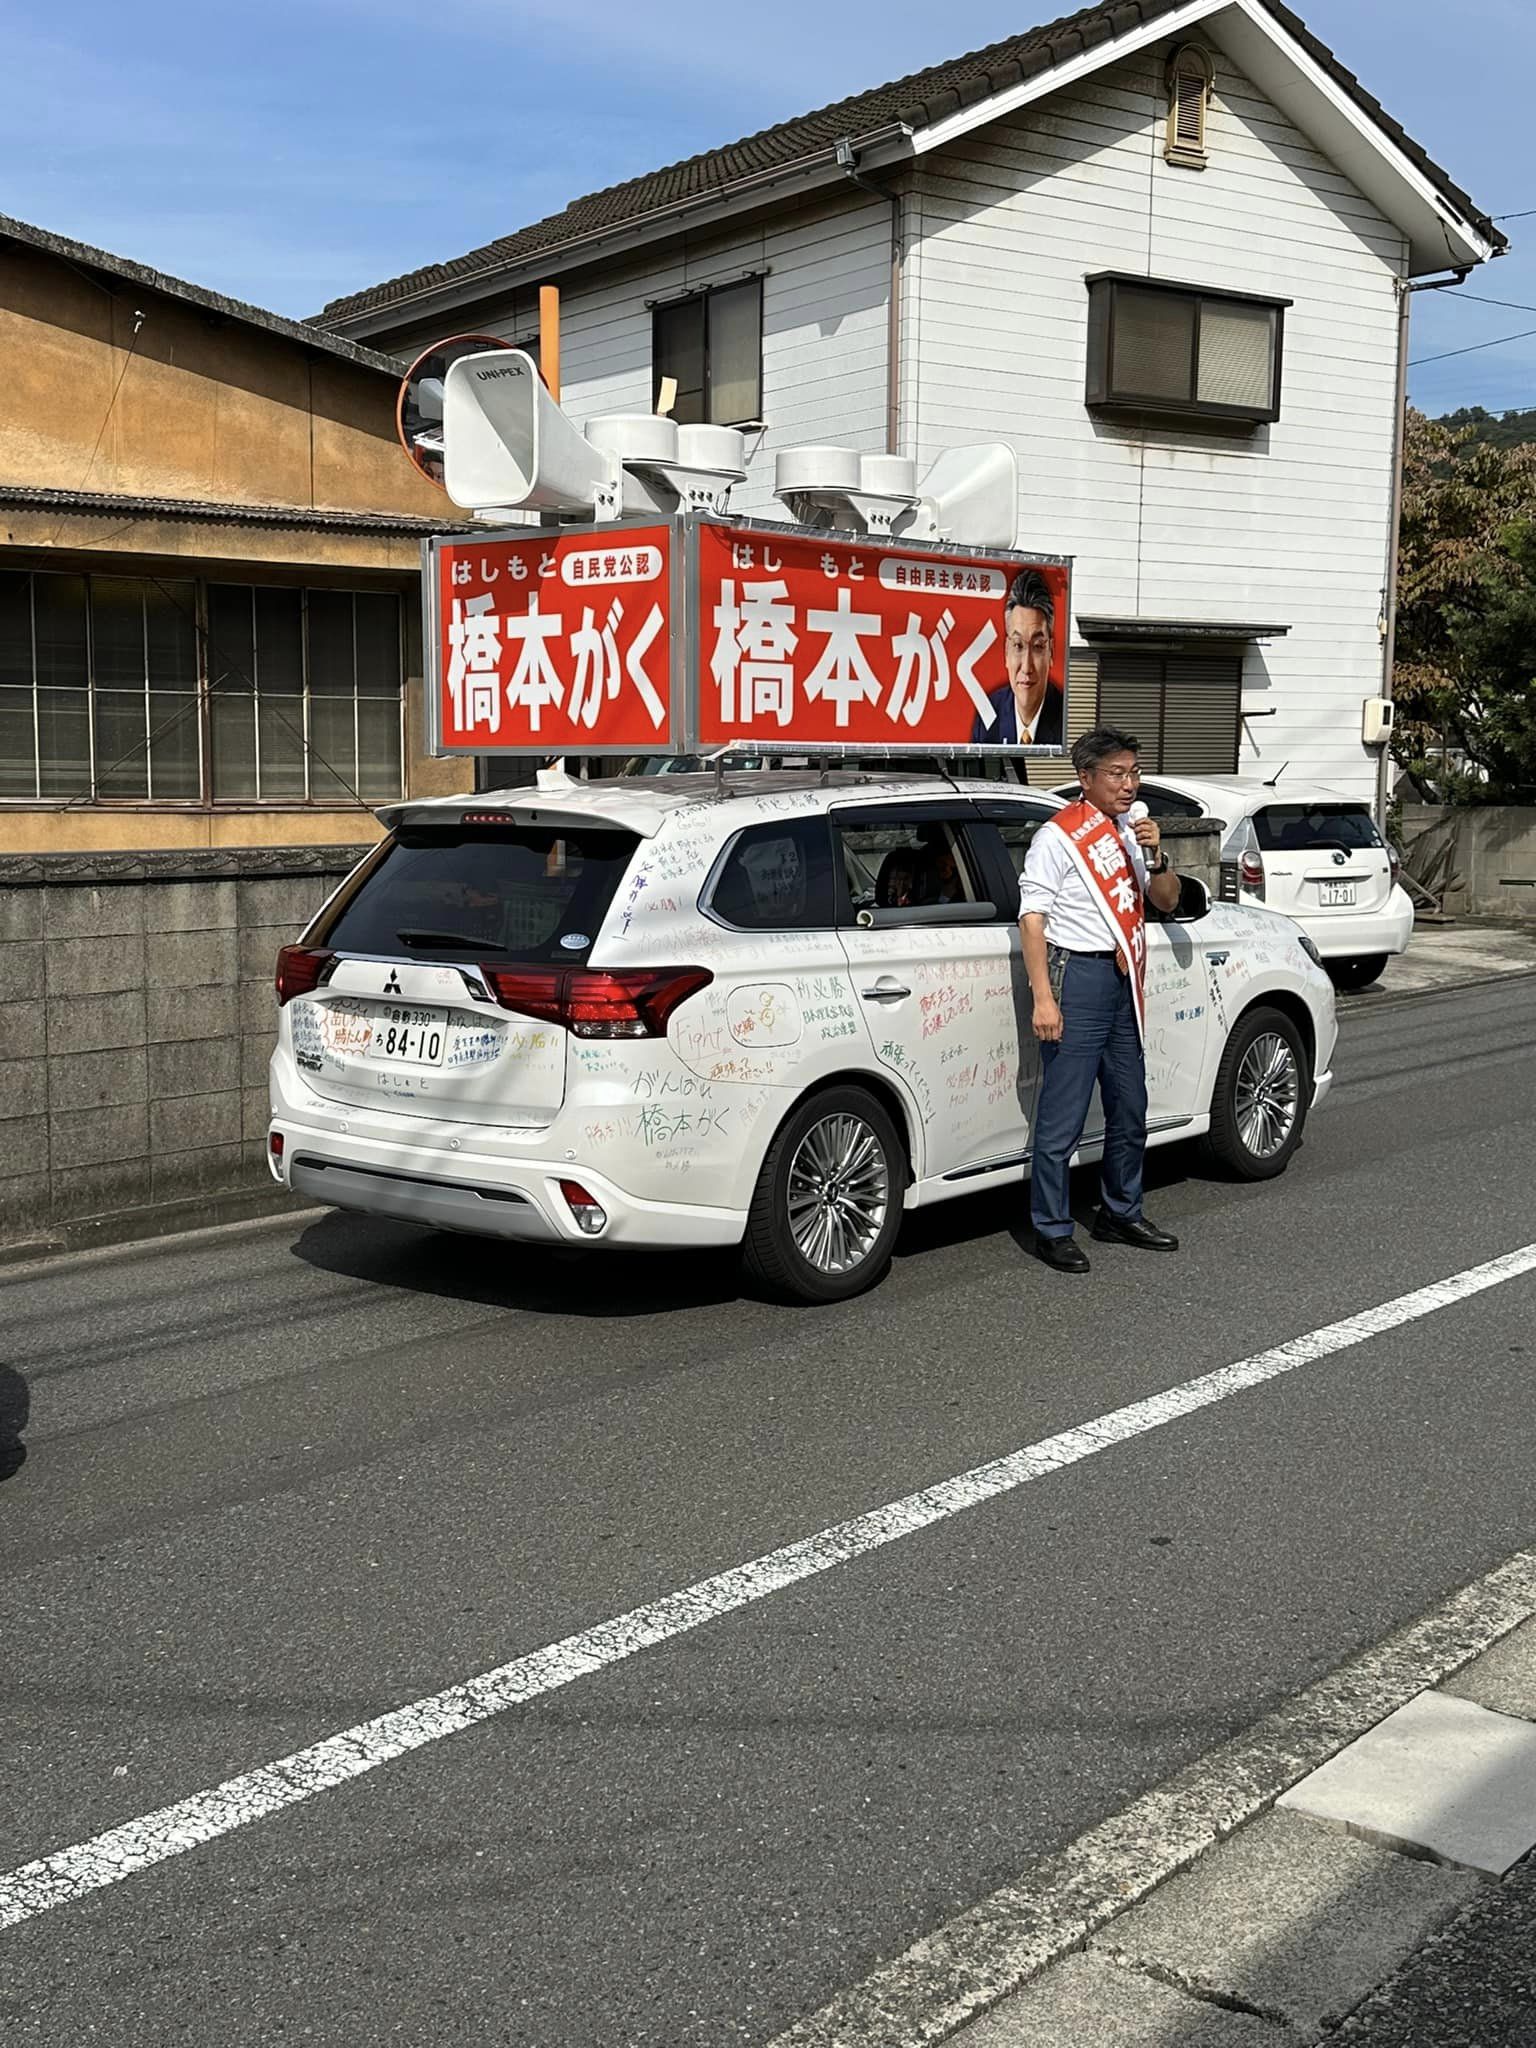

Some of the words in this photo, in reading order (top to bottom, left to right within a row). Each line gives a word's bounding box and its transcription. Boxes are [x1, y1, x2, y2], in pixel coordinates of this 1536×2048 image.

[451, 552, 557, 585] はしもと
[572, 552, 651, 580] 自民党公認
[895, 565, 993, 593] 自由民主党公認
[446, 590, 667, 734] 橋本がく
[709, 578, 998, 731] 橋本がく
[386, 1027, 440, 1060] 84-10
